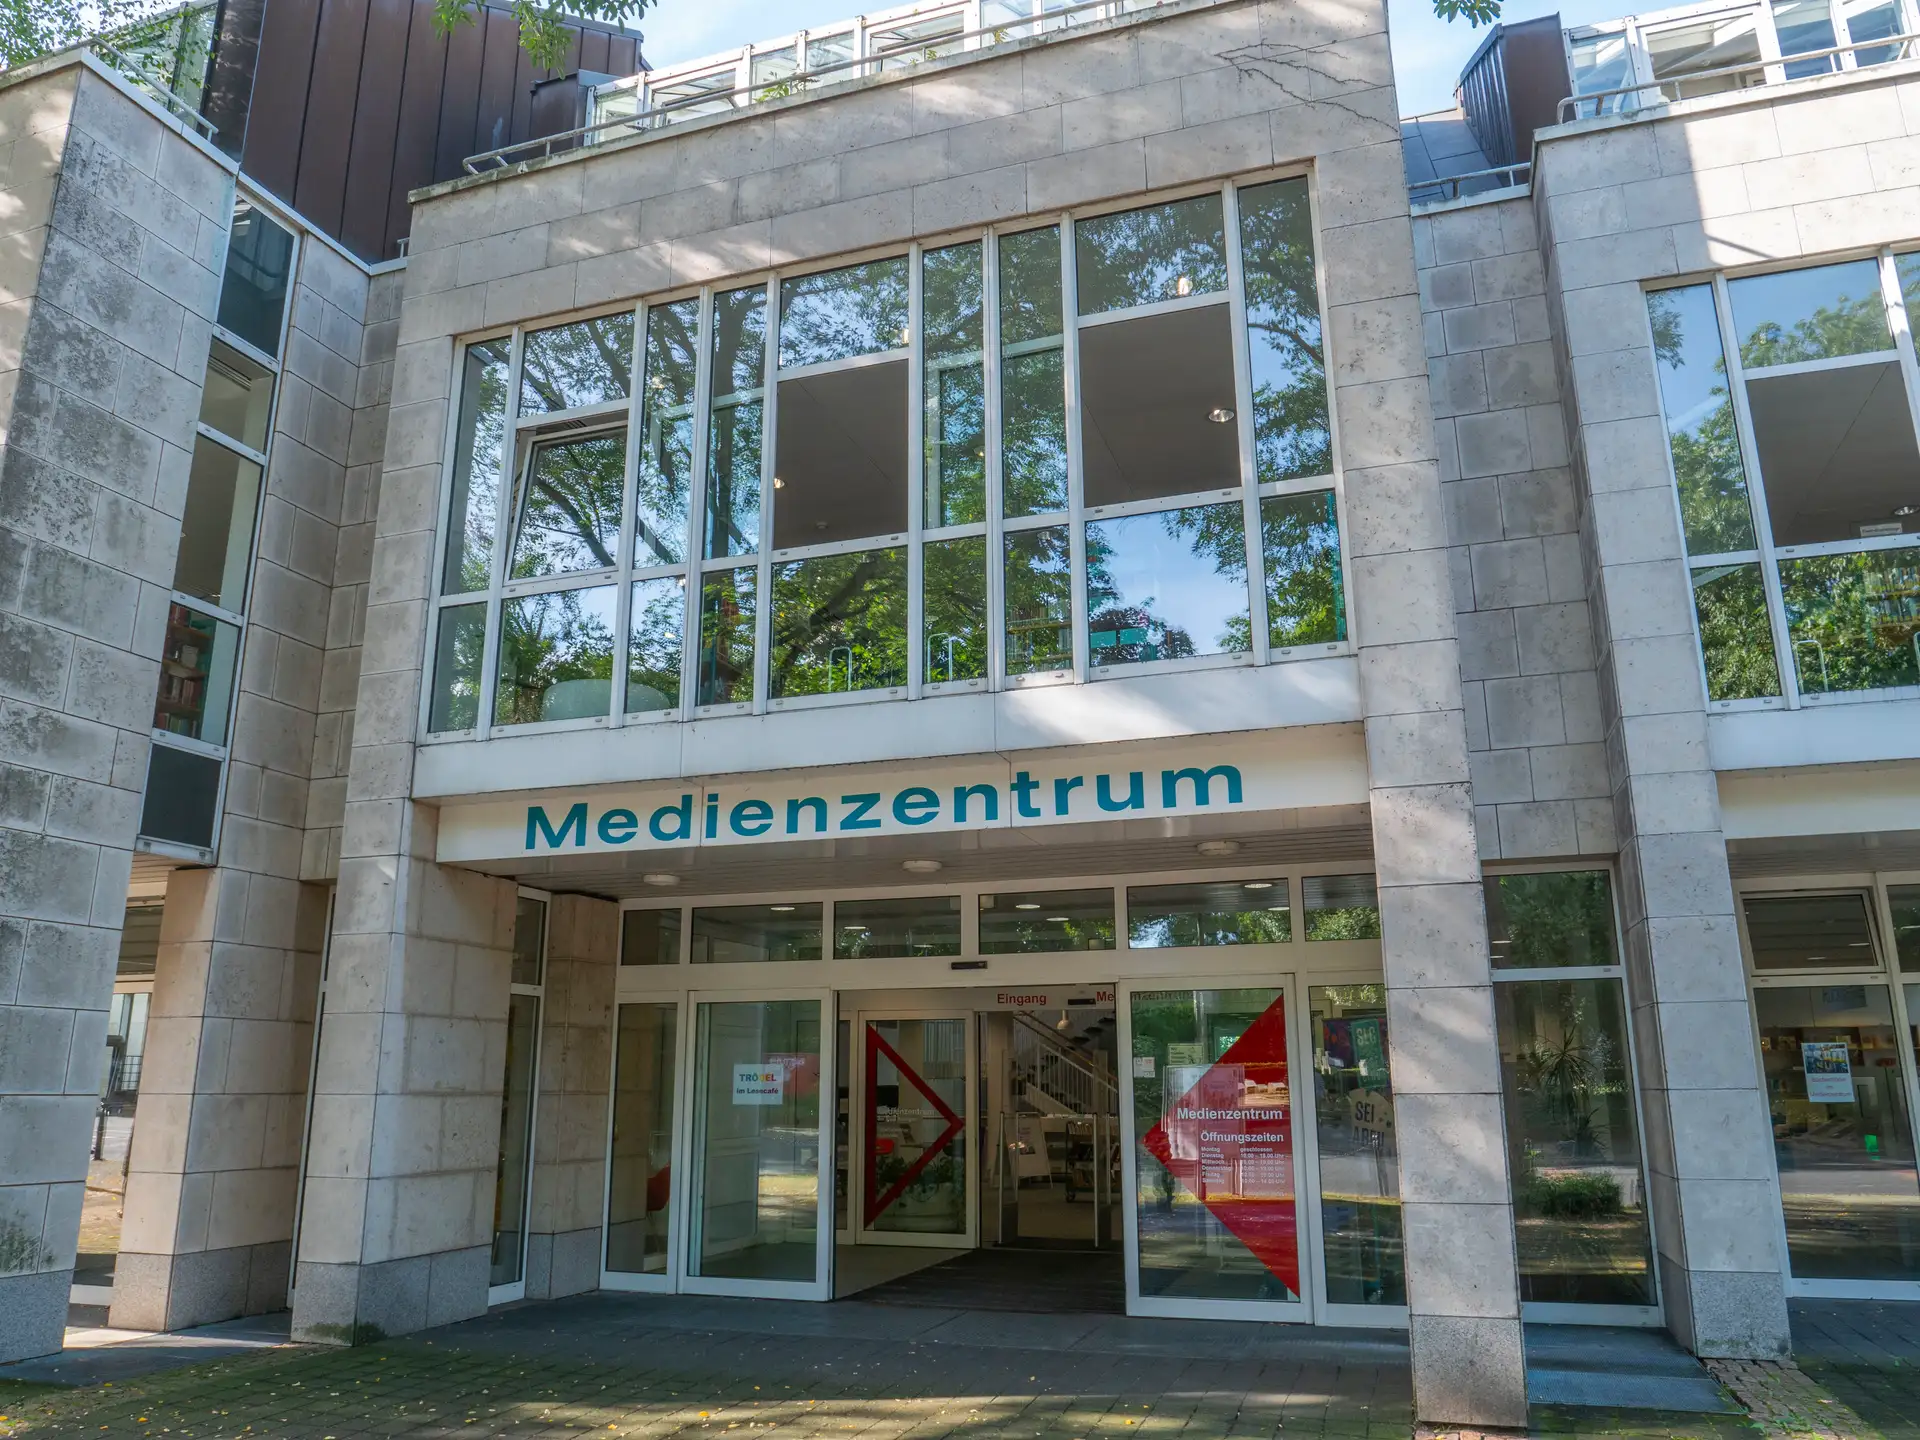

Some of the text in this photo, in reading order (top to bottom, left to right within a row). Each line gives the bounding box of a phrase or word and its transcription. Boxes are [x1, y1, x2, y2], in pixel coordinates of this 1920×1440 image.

[525, 763, 1244, 850] Medienzentrum
[997, 993, 1047, 1006] Eingang
[739, 1072, 777, 1082] TRÖDEL
[1177, 1107, 1283, 1120] Medienzentrum
[1355, 1101, 1375, 1124] SEI
[1200, 1130, 1284, 1144] Öffnungszeiten
